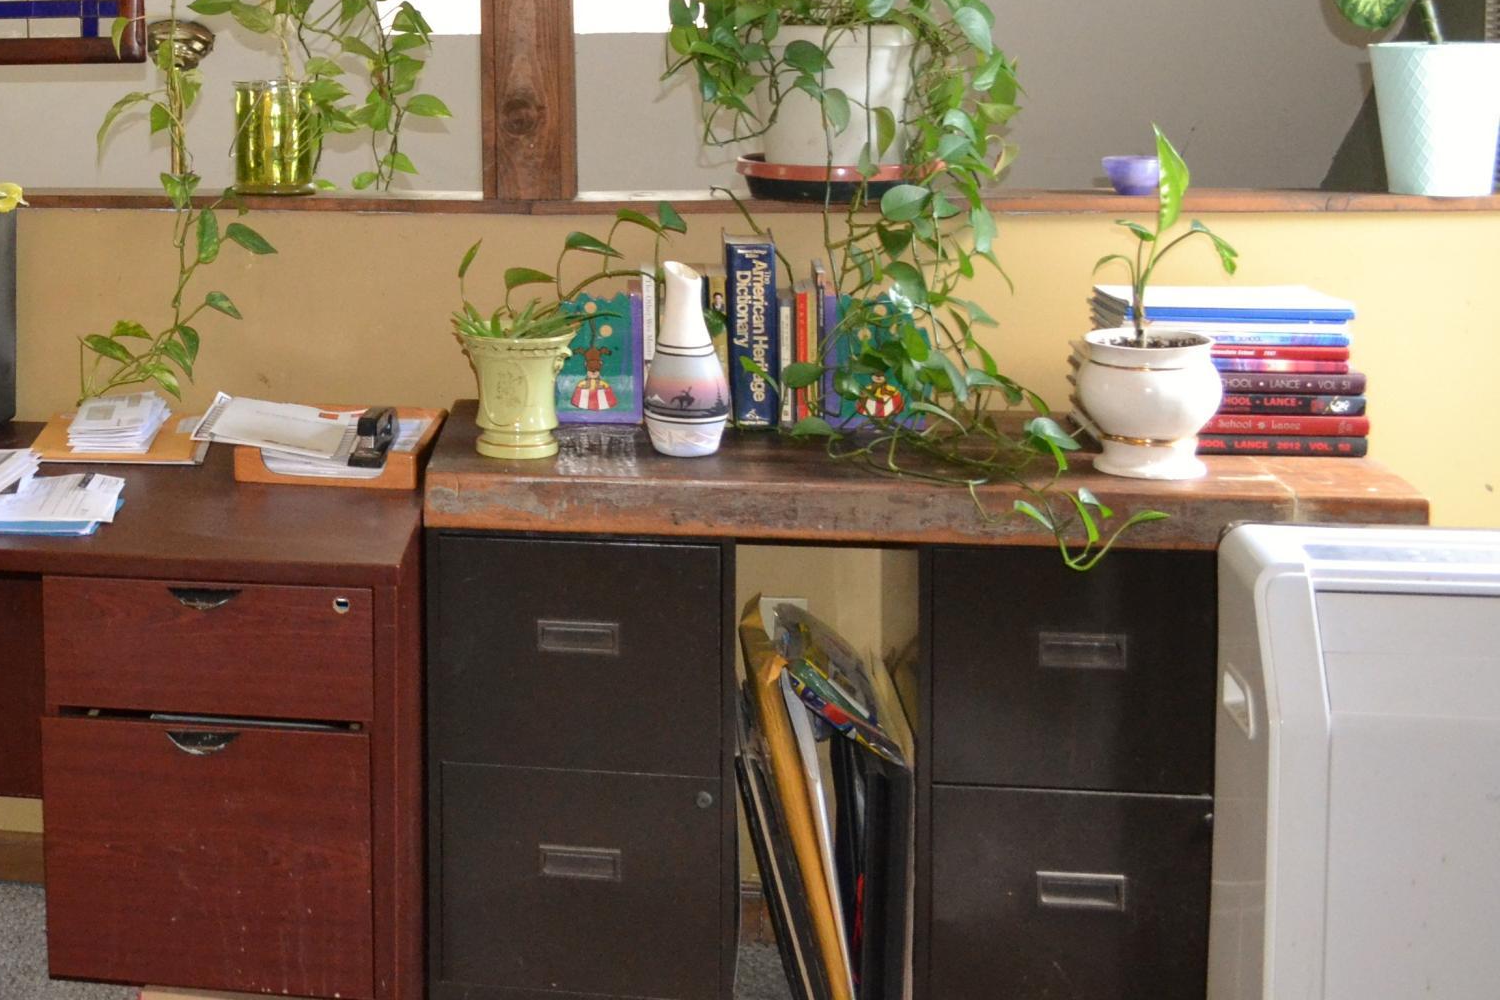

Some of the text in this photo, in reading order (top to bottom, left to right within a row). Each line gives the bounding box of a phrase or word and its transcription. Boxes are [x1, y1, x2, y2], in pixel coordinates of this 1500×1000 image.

[763, 270, 772, 285] The
[752, 259, 769, 334] American
[733, 269, 752, 348] Dictionary
[1269, 378, 1301, 389] LANCE
[1263, 397, 1298, 407] LANCE
[1234, 440, 1269, 450] LANCE
